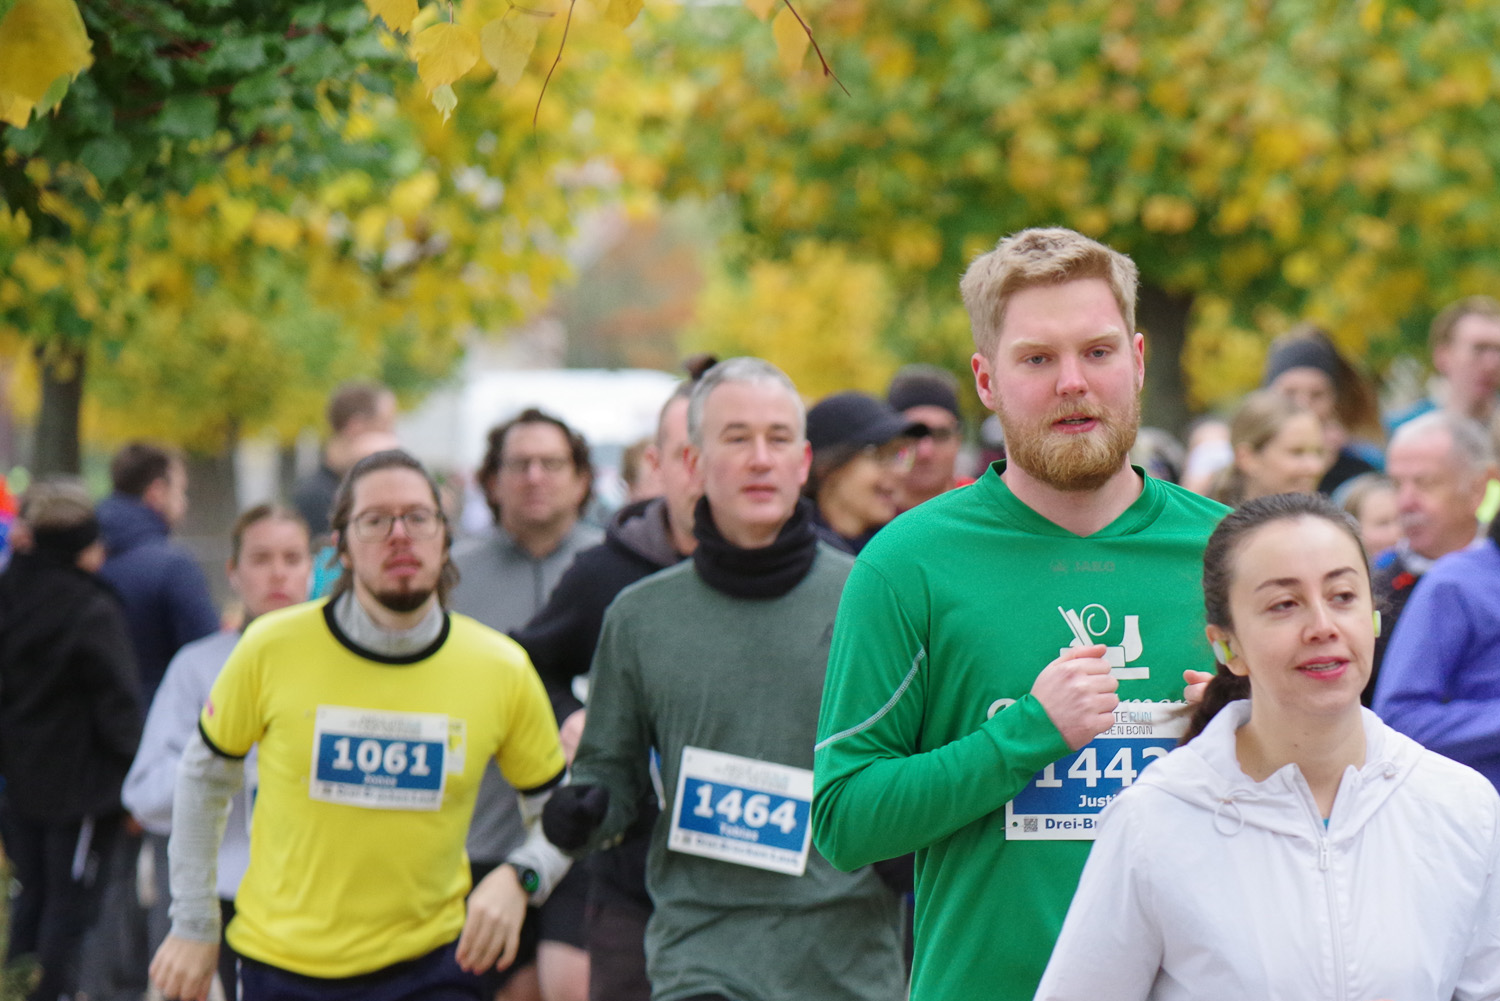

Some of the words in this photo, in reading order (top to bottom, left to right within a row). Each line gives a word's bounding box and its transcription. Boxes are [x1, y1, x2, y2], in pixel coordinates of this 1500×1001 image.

[1126, 725, 1153, 735] BONN
[332, 737, 430, 776] 1061
[694, 783, 797, 834] 1464
[1079, 794, 1116, 807] Just
